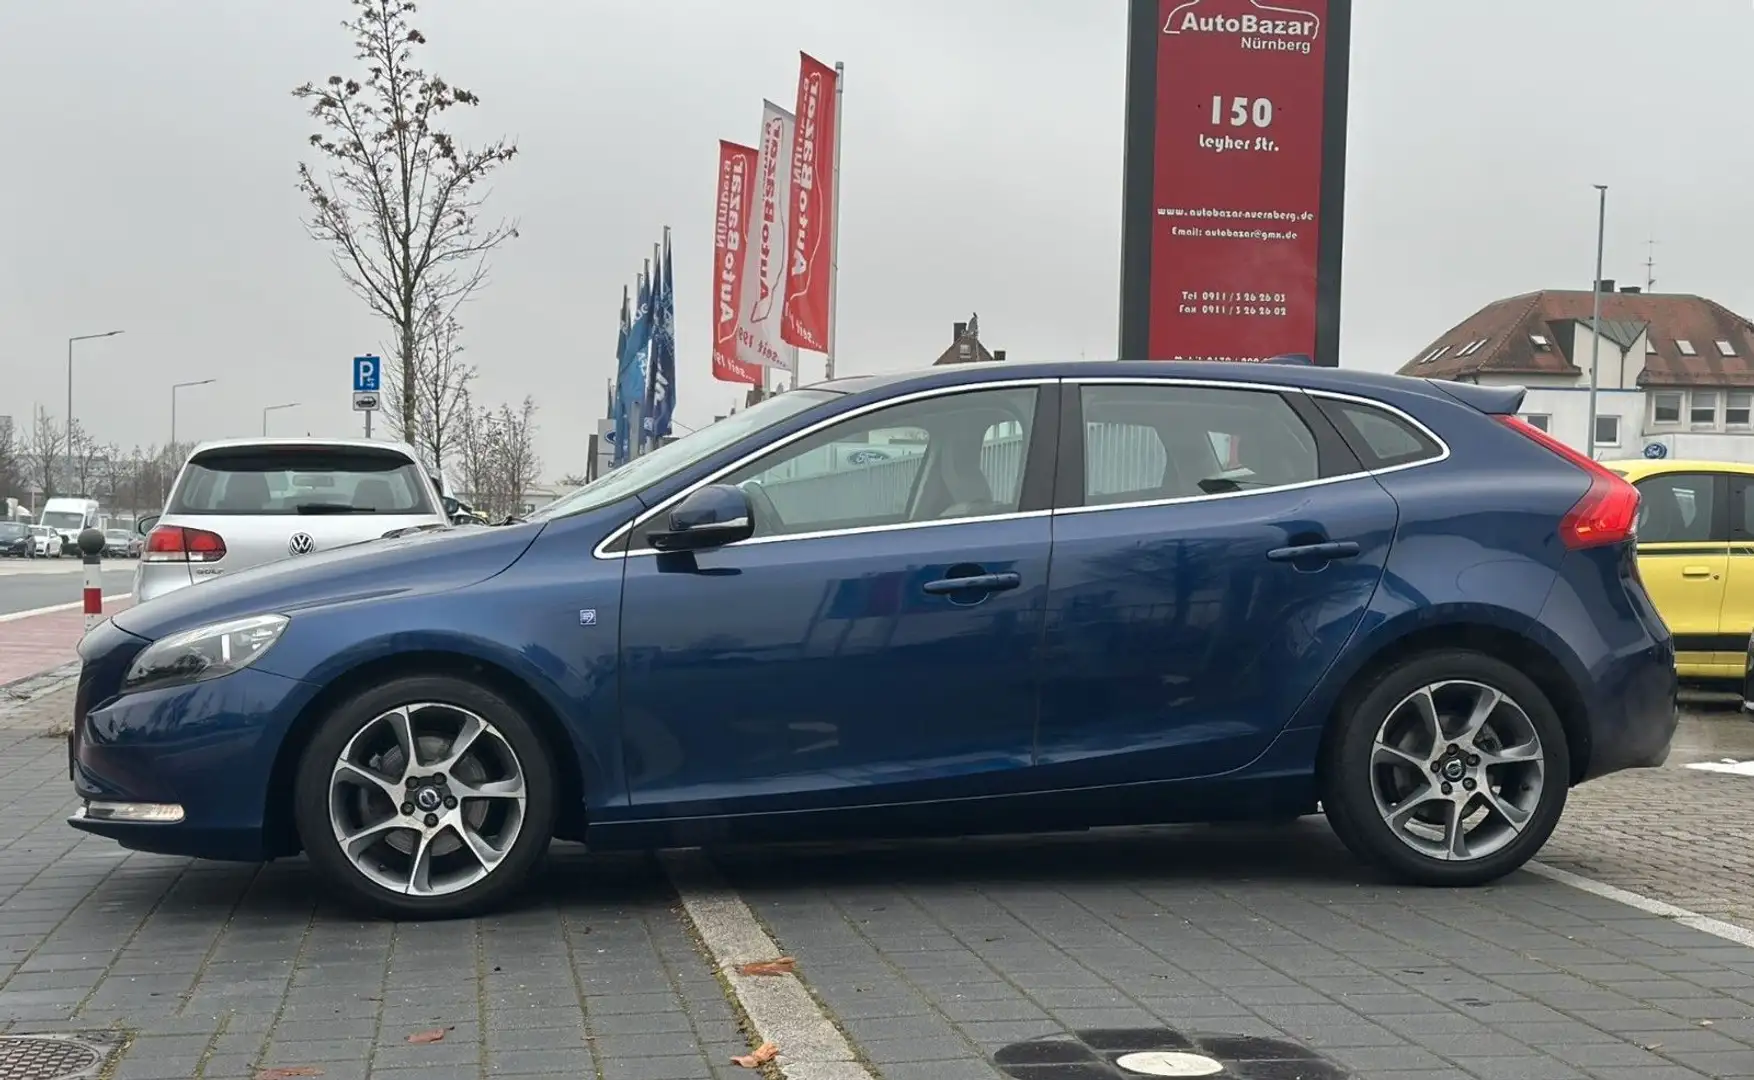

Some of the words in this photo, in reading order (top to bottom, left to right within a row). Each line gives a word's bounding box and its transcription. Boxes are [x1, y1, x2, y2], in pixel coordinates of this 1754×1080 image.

[1181, 12, 1314, 35] AutoBazar
[1241, 37, 1311, 54] Nürnberg
[1211, 96, 1273, 128] 150
[1199, 134, 1250, 152] Leyher
[1254, 136, 1279, 152] Str.
[1157, 208, 1315, 222] www.autobazar-nuernberg.de
[1171, 226, 1202, 237] Email:
[1204, 228, 1298, 241] autobazar@gmx.de
[1179, 304, 1197, 314] Fax
[360, 361, 374, 387] P
